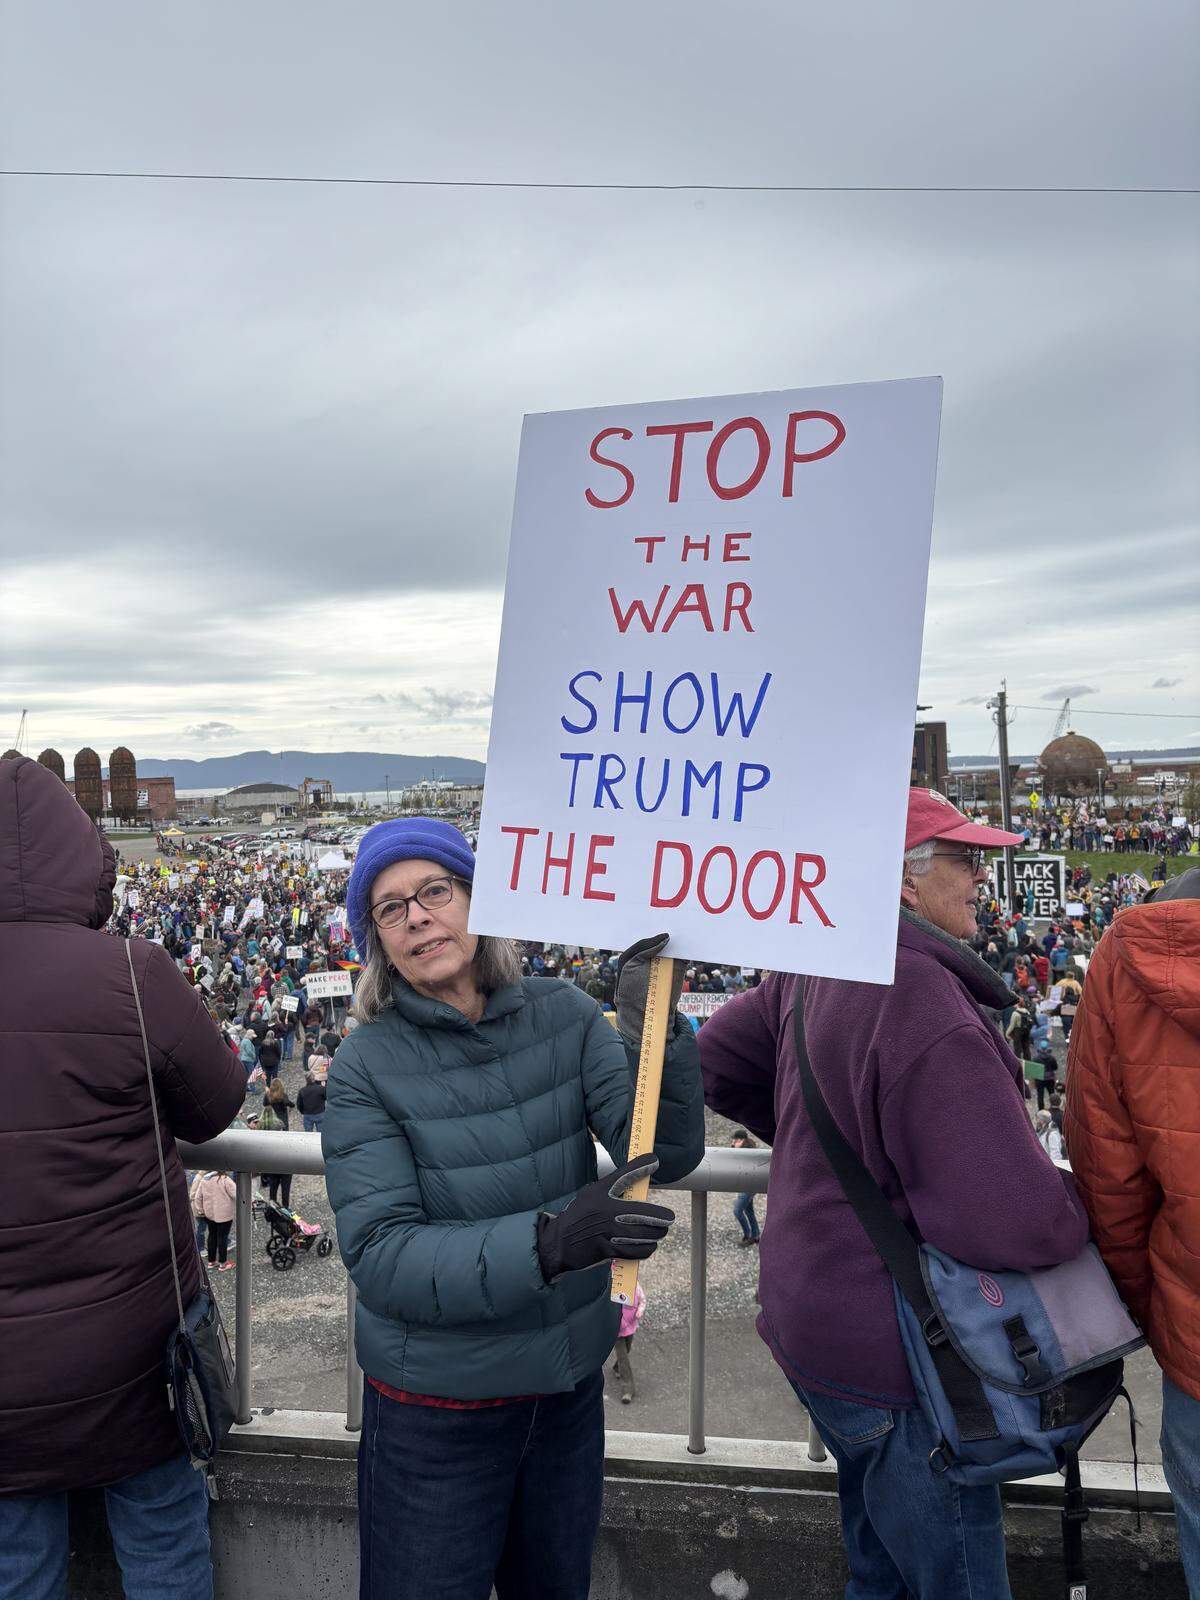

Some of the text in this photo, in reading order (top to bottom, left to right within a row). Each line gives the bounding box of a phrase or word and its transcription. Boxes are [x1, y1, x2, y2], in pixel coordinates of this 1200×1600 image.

[584, 410, 847, 509] STOP
[635, 532, 752, 563] THE
[608, 582, 755, 633] WAR
[561, 670, 772, 738] SHOW
[560, 752, 771, 822] TRUMP
[501, 826, 836, 928] THE DOOR
[1003, 863, 1055, 879] LACK
[999, 898, 1059, 915] MTTER
[308, 975, 328, 983] MAKE
